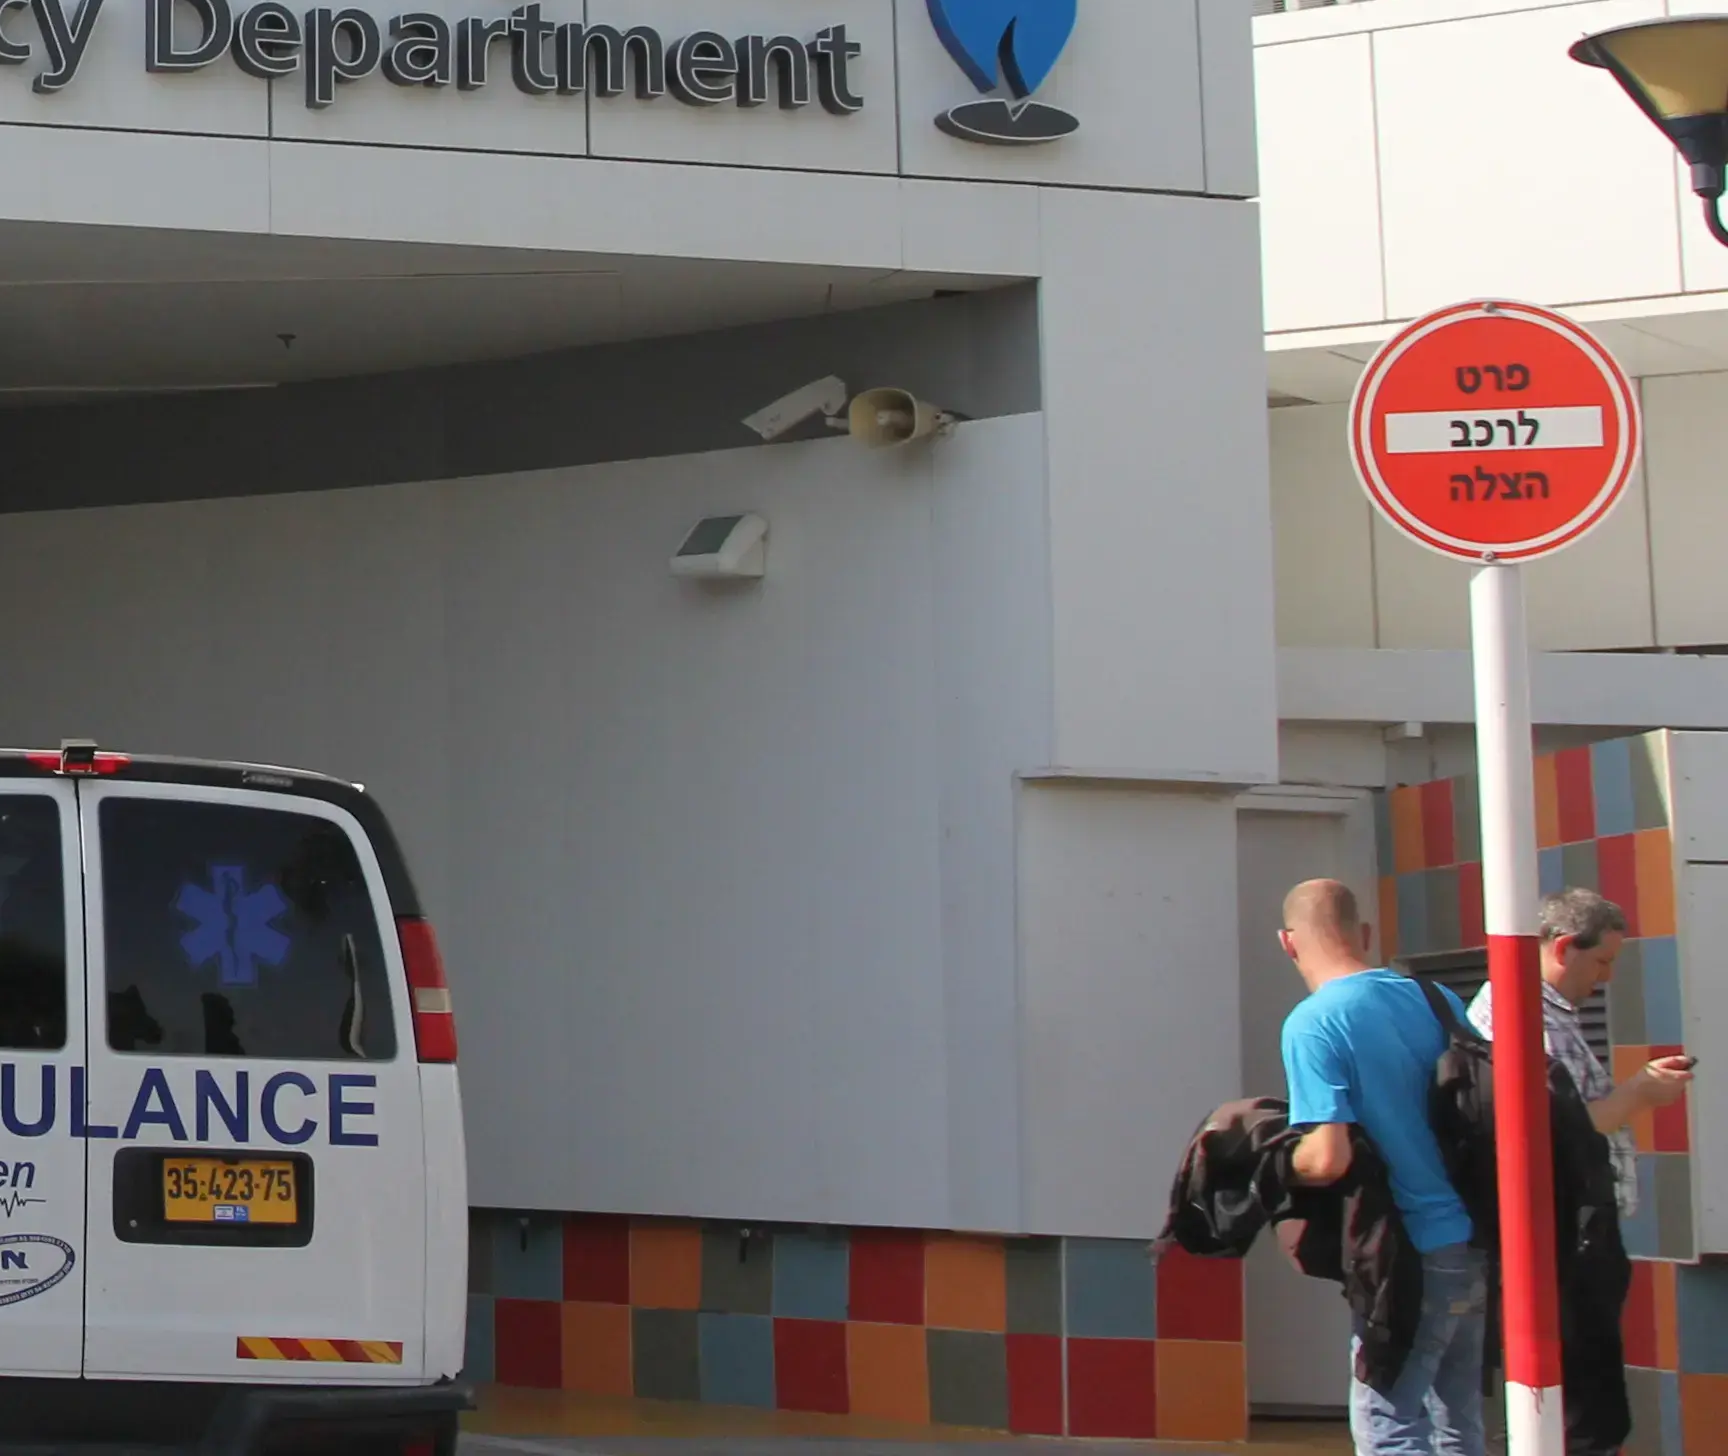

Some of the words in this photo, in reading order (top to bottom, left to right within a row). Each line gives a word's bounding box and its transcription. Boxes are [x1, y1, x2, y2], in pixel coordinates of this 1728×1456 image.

[1454, 363, 1531, 394] פרט
[1449, 410, 1540, 448] לרכב
[1448, 465, 1551, 502] הצלה
